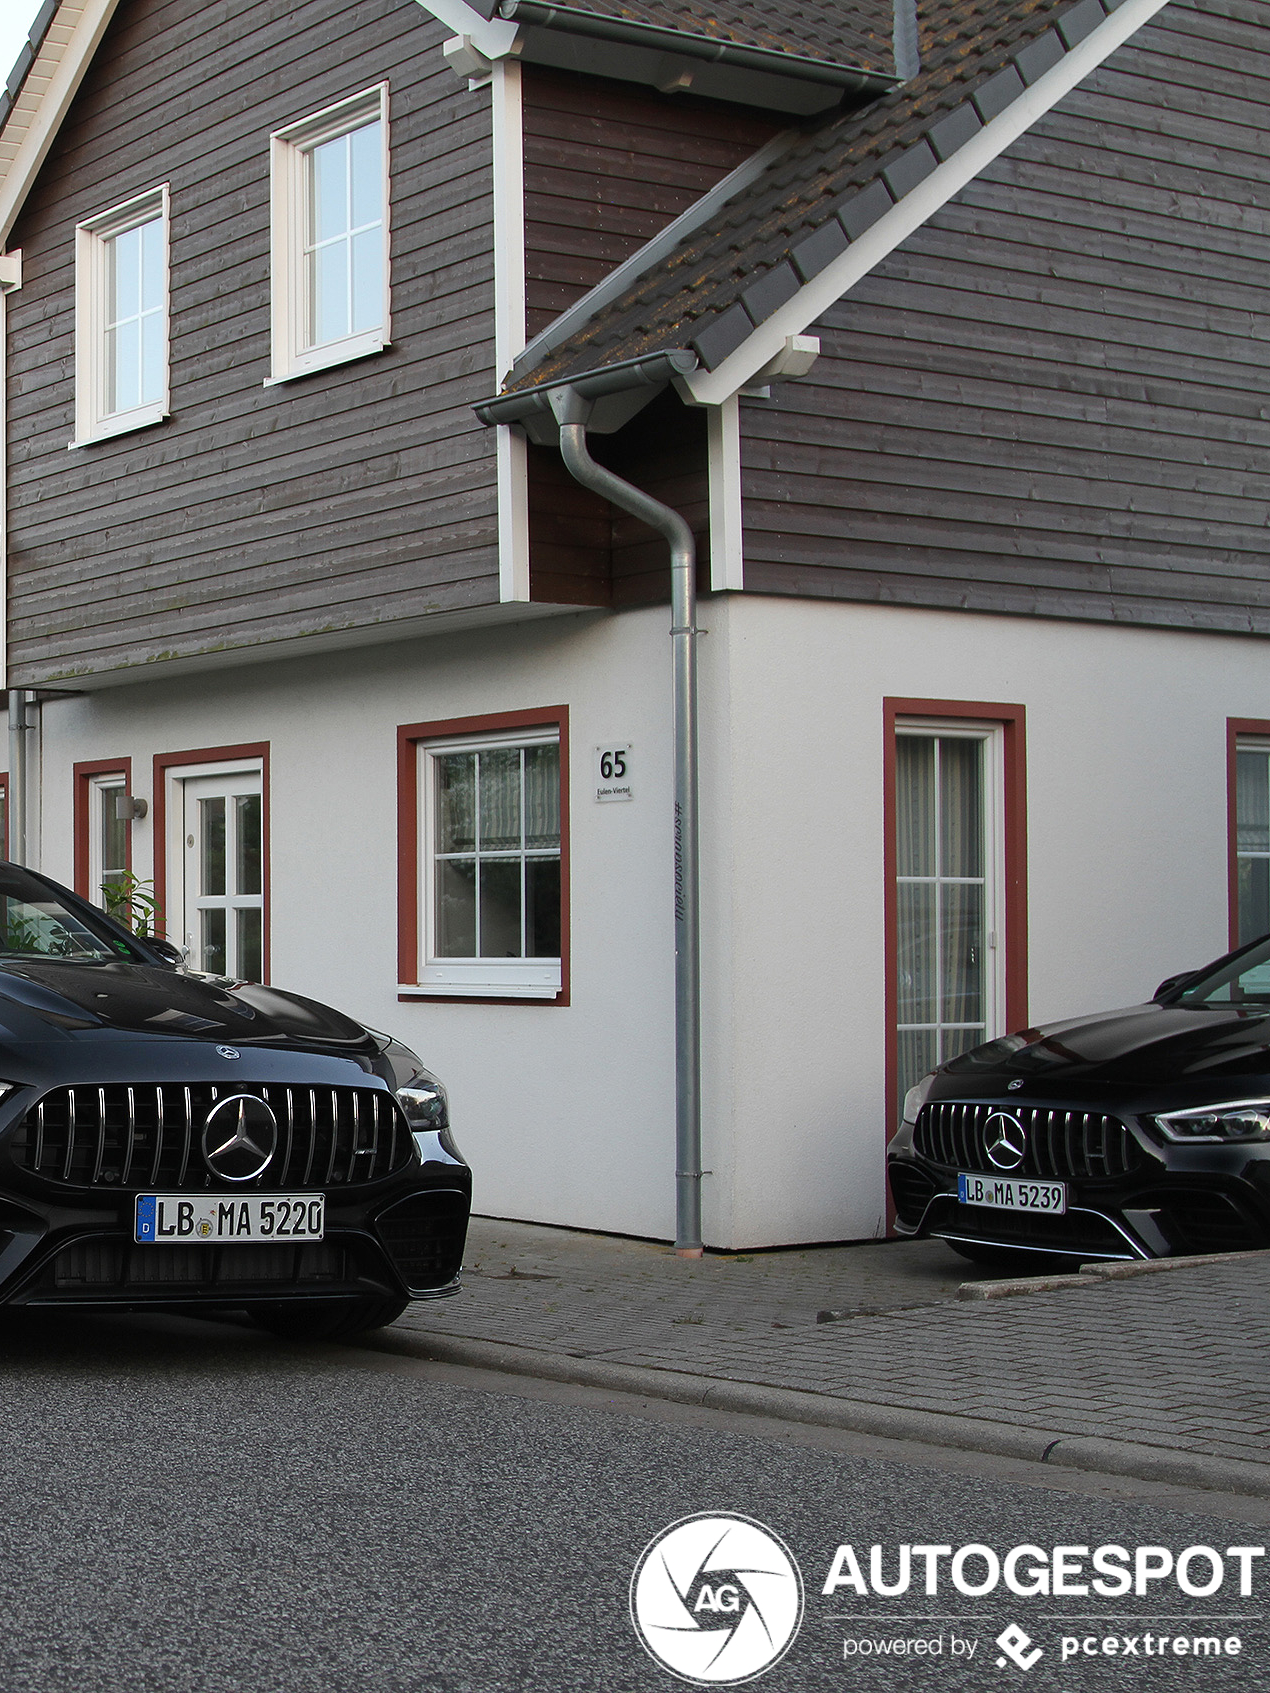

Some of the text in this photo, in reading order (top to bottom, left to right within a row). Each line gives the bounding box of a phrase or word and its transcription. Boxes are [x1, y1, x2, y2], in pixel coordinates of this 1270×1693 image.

[601, 751, 625, 778] 65
[966, 1178, 1062, 1209] LB MA 5239
[142, 1223, 150, 1233] D
[158, 1201, 322, 1236] LB MA 5220
